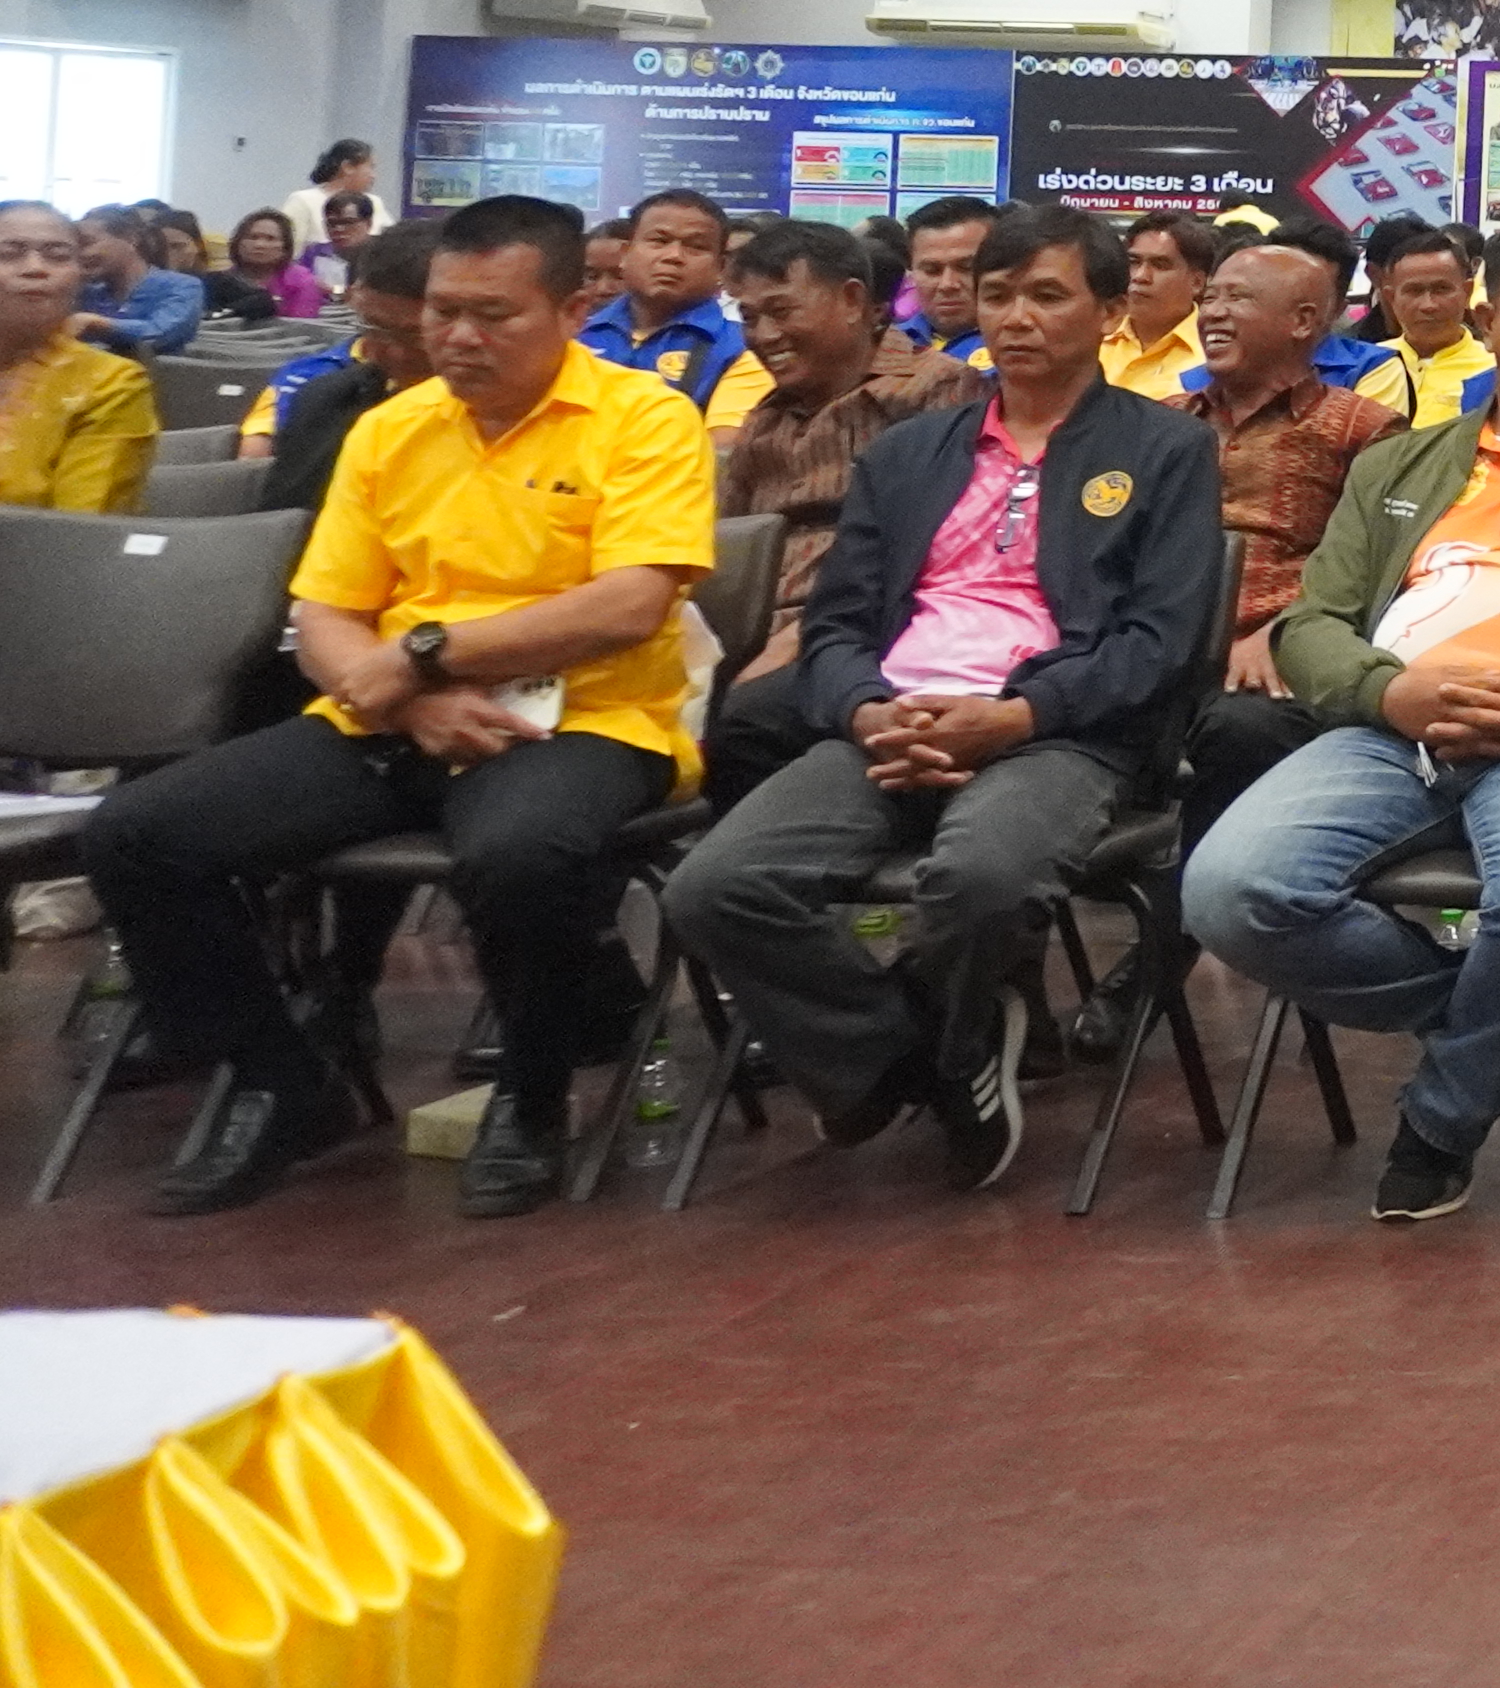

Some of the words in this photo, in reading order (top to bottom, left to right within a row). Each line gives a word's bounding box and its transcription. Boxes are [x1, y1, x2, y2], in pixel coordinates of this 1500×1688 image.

[747, 87, 757, 99] 3
[1038, 167, 1184, 191] เร่งด่วนระยะ
[1190, 175, 1207, 192] 3
[1213, 171, 1274, 194] เดือน
[1133, 196, 1193, 210] สิงหาคม
